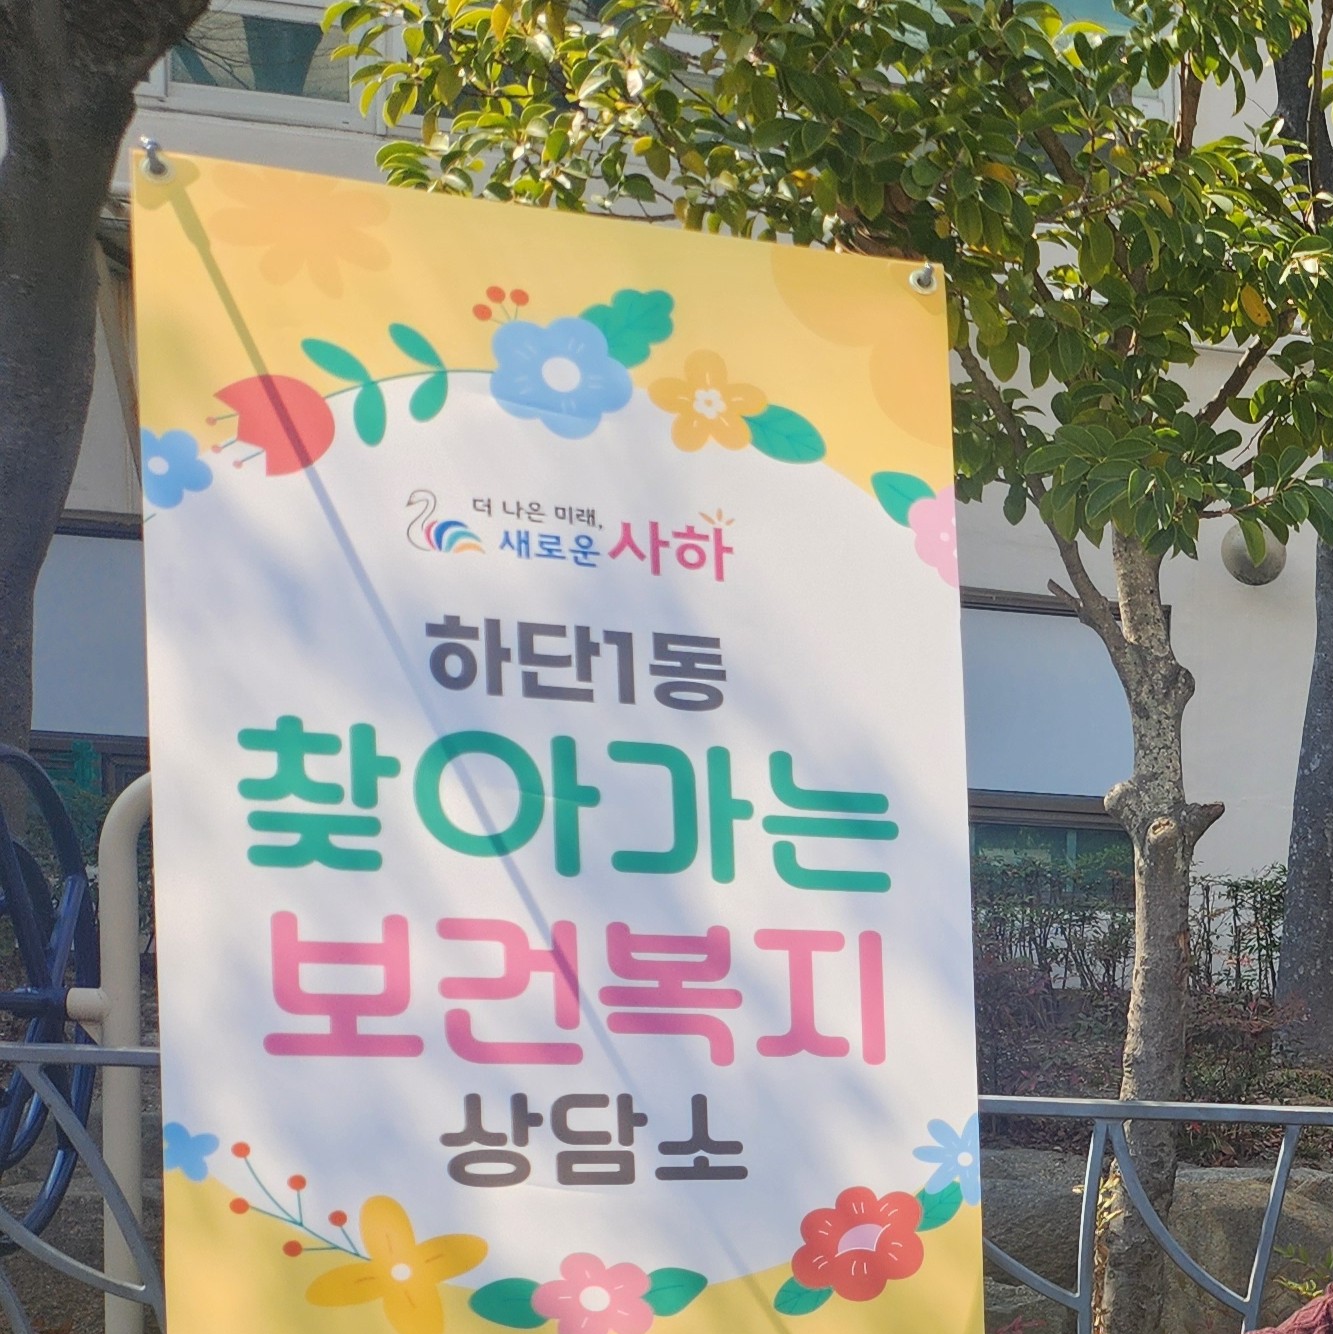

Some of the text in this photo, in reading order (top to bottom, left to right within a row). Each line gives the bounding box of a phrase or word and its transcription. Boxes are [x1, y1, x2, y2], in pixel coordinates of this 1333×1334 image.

[472, 498, 603, 530] 더 나은 미래,
[500, 520, 735, 582] 새로운 사하
[425, 614, 727, 712] 하단1동
[237, 714, 900, 893] 찾아가는
[262, 910, 887, 1067] 보건복지
[439, 1093, 749, 1188] 상담소
